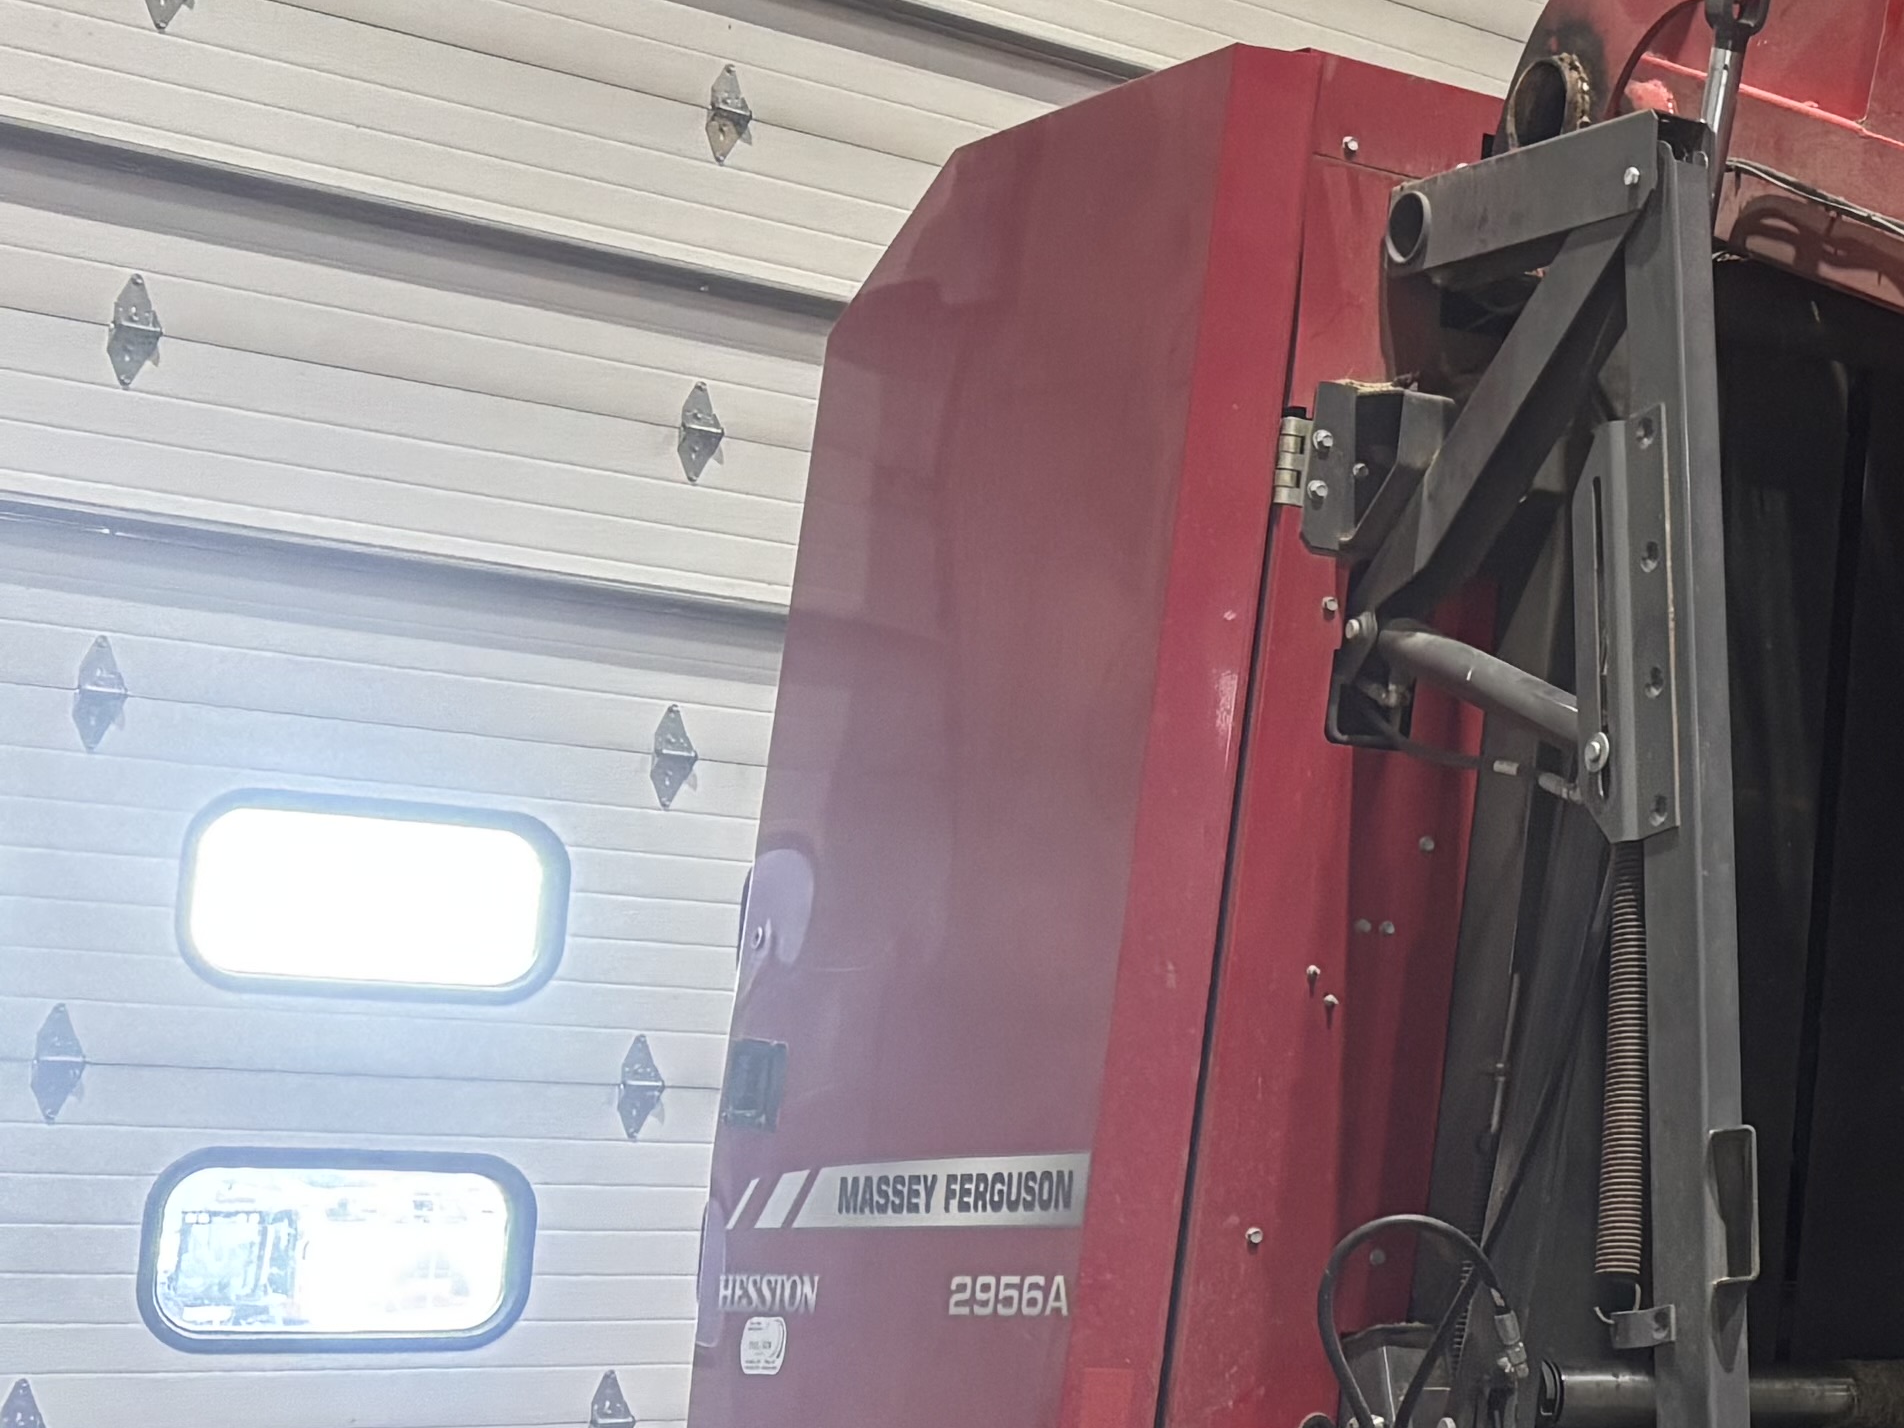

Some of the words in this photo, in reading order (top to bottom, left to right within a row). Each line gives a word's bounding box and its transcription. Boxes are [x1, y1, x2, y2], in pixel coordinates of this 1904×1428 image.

[837, 1173, 938, 1215] MASSEY
[943, 1169, 1075, 1214] FERGUSON
[717, 1274, 820, 1316] HESSTON
[948, 1275, 1069, 1317] 2956A
